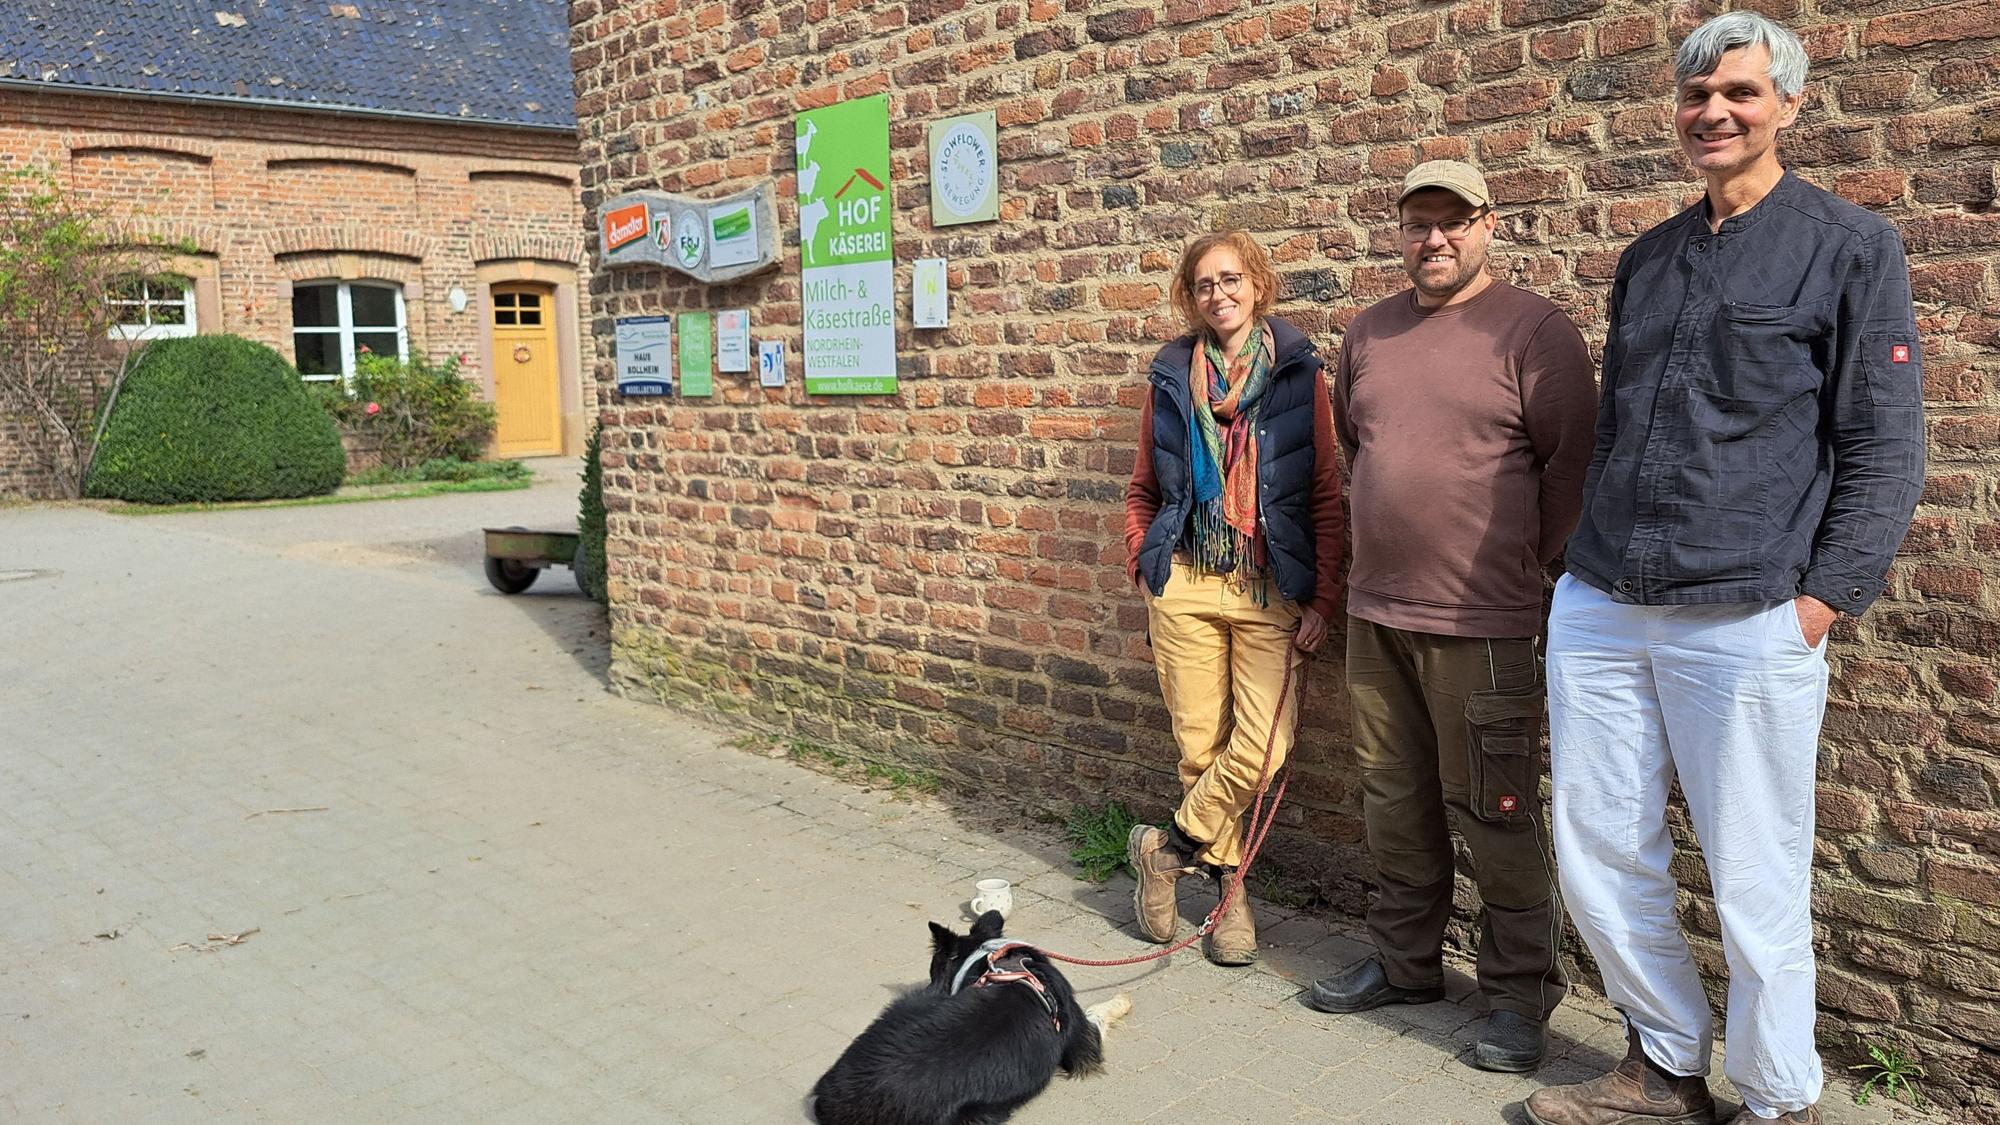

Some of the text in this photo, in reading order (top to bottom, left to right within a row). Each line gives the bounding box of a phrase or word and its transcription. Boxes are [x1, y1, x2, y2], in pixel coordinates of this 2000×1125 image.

[941, 133, 986, 173] SLOWFLOWER
[943, 177, 984, 206] BEWEGUNG
[838, 196, 881, 227] HOF
[609, 216, 643, 244] demeter
[829, 231, 886, 257] KÄSEREI
[805, 279, 867, 303] Milch- &
[806, 304, 892, 330] Käsestraße
[634, 352, 651, 361] HAUS
[807, 336, 863, 352] NORDRHEIN-
[627, 365, 660, 374] BOLLHEIM
[807, 354, 860, 369] WESTFALEN
